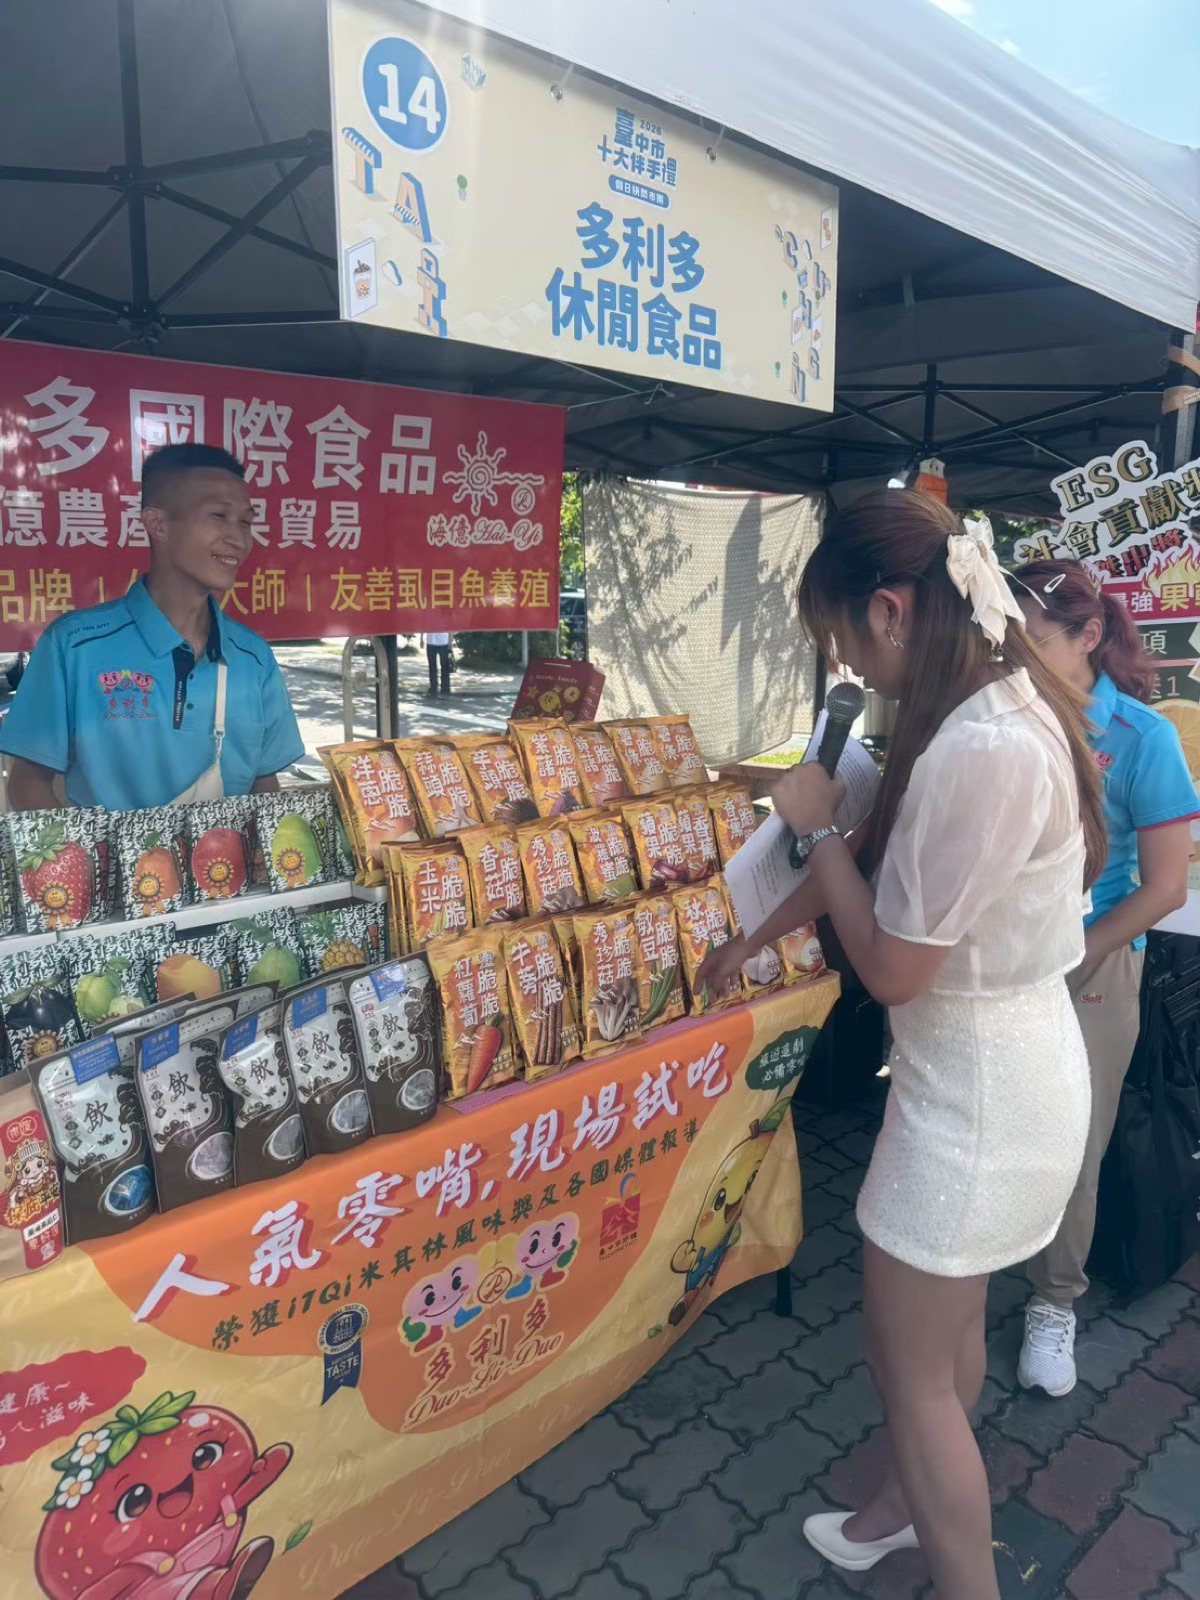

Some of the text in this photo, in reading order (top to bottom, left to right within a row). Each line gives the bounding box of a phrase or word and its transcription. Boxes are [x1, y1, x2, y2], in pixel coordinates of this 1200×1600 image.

[378, 63, 441, 134] 14
[614, 107, 665, 159] 臺中市
[640, 119, 662, 135] 2026
[597, 134, 677, 187] 十大伴手禮
[576, 201, 705, 293] 多利多
[545, 266, 722, 371] 休閒食品
[1056, 446, 1154, 512] ESG
[429, 515, 470, 545] 海億
[330, 566, 551, 613] 友善虱目魚養殖
[415, 751, 445, 798] 蒜頭
[471, 749, 502, 791] 芋頭
[553, 745, 579, 789] 脆脆
[593, 745, 622, 782] 脆脆
[636, 739, 664, 776] 脆脆
[676, 735, 702, 769] 脆脆
[378, 769, 412, 819] 脆脆
[438, 763, 471, 810] 脆脆
[494, 761, 528, 802] 脆脆
[605, 837, 630, 876] 脆脆
[638, 811, 663, 858] 蘋果
[657, 823, 684, 866] 脆脆
[692, 816, 717, 861] 香蕉
[417, 860, 442, 913] 玉米
[479, 844, 504, 902] 香菇
[499, 857, 522, 910] 脆脆
[531, 836, 557, 897] 秀珍菇
[552, 847, 575, 889] 脆脆
[441, 875, 467, 929] 脆脆
[593, 922, 614, 986] 秀珍菇
[613, 936, 632, 979] 脆脆
[635, 910, 659, 962] 敏豆
[655, 922, 678, 970] 脆脆
[453, 957, 479, 1028] 紅蘿蔔
[477, 969, 500, 1019] 脆脆
[535, 952, 564, 1006] 脆脆
[312, 1031, 335, 1059] 飲
[382, 1013, 404, 1039] 飲
[168, 1071, 195, 1102] 飲
[250, 1057, 275, 1084] 飲
[83, 1101, 114, 1133] 飲
[326, 1354, 360, 1378] TASTE
[412, 1297, 548, 1397] 多利多
